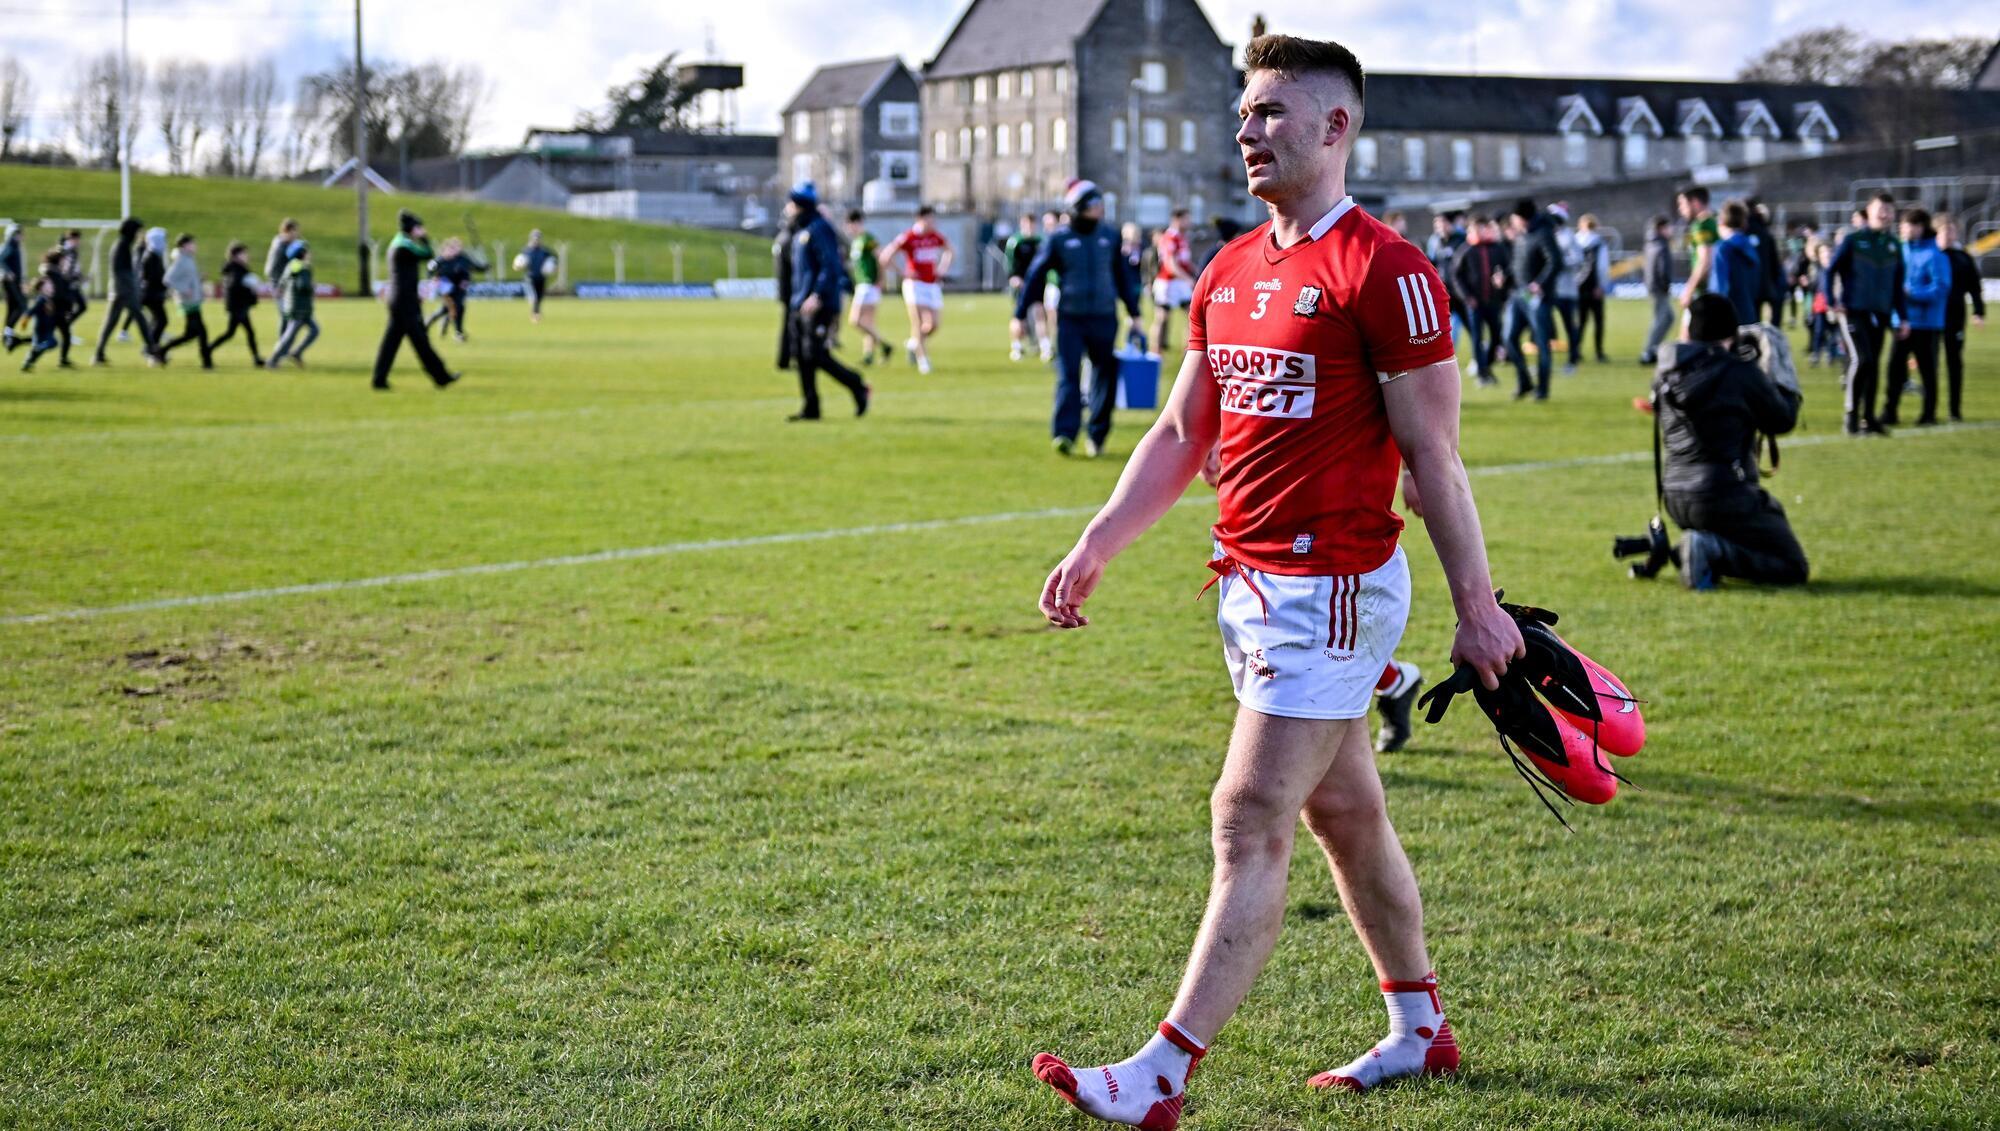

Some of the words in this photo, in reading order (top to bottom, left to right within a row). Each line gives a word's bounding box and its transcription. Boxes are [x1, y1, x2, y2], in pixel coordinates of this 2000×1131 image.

[1249, 292, 1271, 320] 3
[1209, 348, 1304, 379] SPORTS
[1220, 383, 1304, 414] RECT
